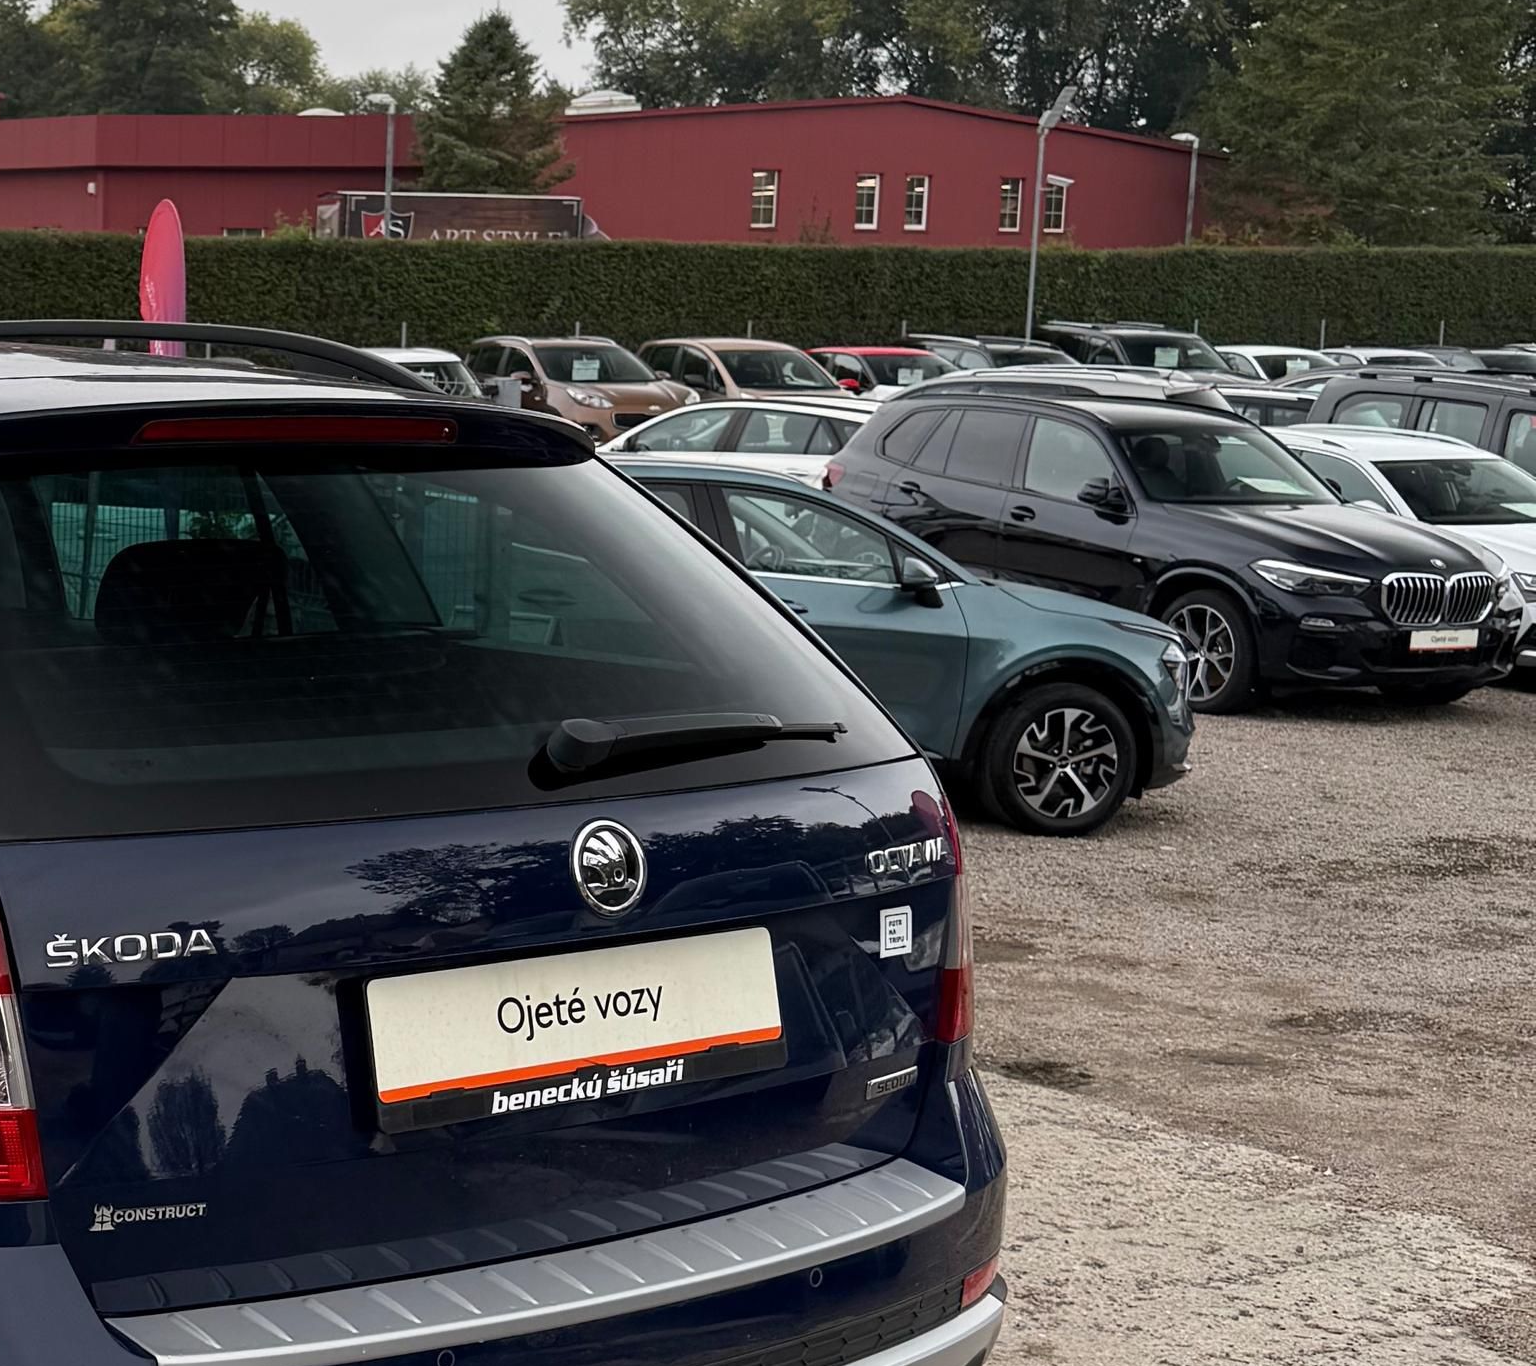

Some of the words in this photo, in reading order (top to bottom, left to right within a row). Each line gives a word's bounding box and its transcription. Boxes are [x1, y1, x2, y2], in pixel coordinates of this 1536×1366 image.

[46, 929, 217, 968] ŠKODA
[497, 987, 586, 1041] Ojeté
[594, 985, 663, 1022] vozy
[491, 1073, 602, 1115] benecký
[606, 1059, 685, 1095] šůsaři
[876, 1072, 914, 1094] SCOUT
[113, 1203, 207, 1223] CONSTRUCT
